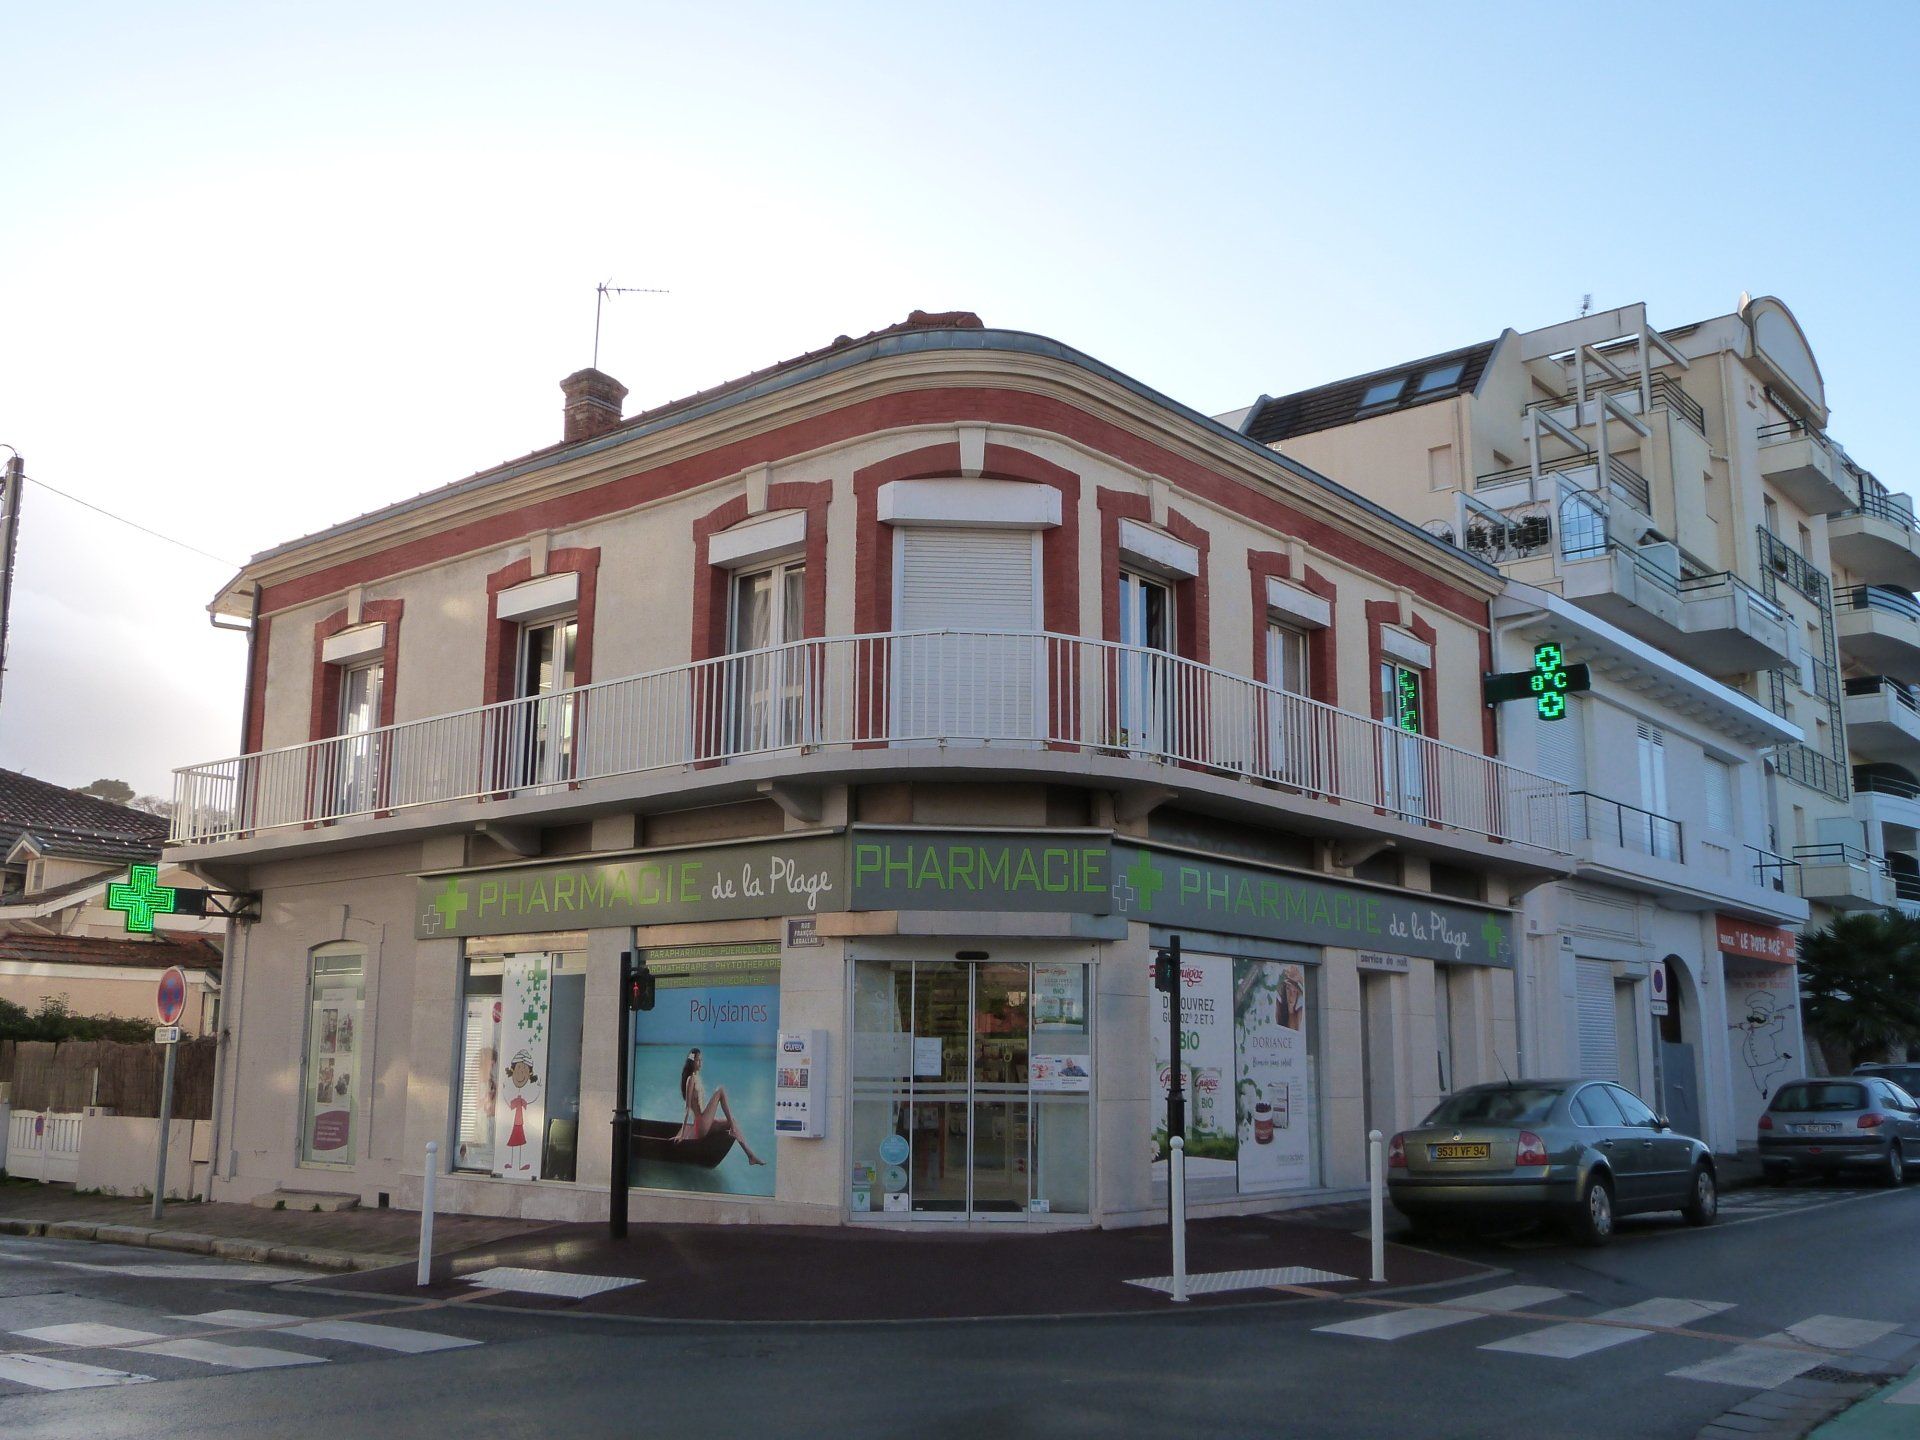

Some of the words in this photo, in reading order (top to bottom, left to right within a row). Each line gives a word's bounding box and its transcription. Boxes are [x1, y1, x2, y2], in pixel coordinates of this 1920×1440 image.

[1530, 672, 1567, 691] 8°C
[856, 845, 1108, 893] PHARMACIE
[478, 861, 704, 919] PHARMACIE
[711, 871, 737, 899] de
[742, 863, 764, 897] la
[769, 855, 833, 911] Plage
[1179, 866, 1382, 935] PHARMACIE
[1388, 913, 1409, 938] de
[1411, 911, 1428, 941] la
[1430, 909, 1471, 959] Plage
[649, 948, 713, 960] PARAPHARMACIE
[720, 944, 778, 955] PUERICULTURE
[1360, 953, 1383, 964] service
[715, 960, 783, 970] PHYTOTHERAPIE
[1162, 996, 1215, 1012] DOUVREZ
[689, 997, 768, 1030] Polysianes
[1194, 1014, 1199, 1025] 2
[1200, 1014, 1209, 1025] ET
[1210, 1015, 1215, 1026] 3
[1252, 1036, 1294, 1049] DORIANCE
[1194, 1073, 1219, 1094] Guigoz
[1209, 1114, 1215, 1128] 3
[1437, 1146, 1458, 1157] 9531
[1460, 1146, 1472, 1156] VF
[1473, 1145, 1486, 1156] 94
